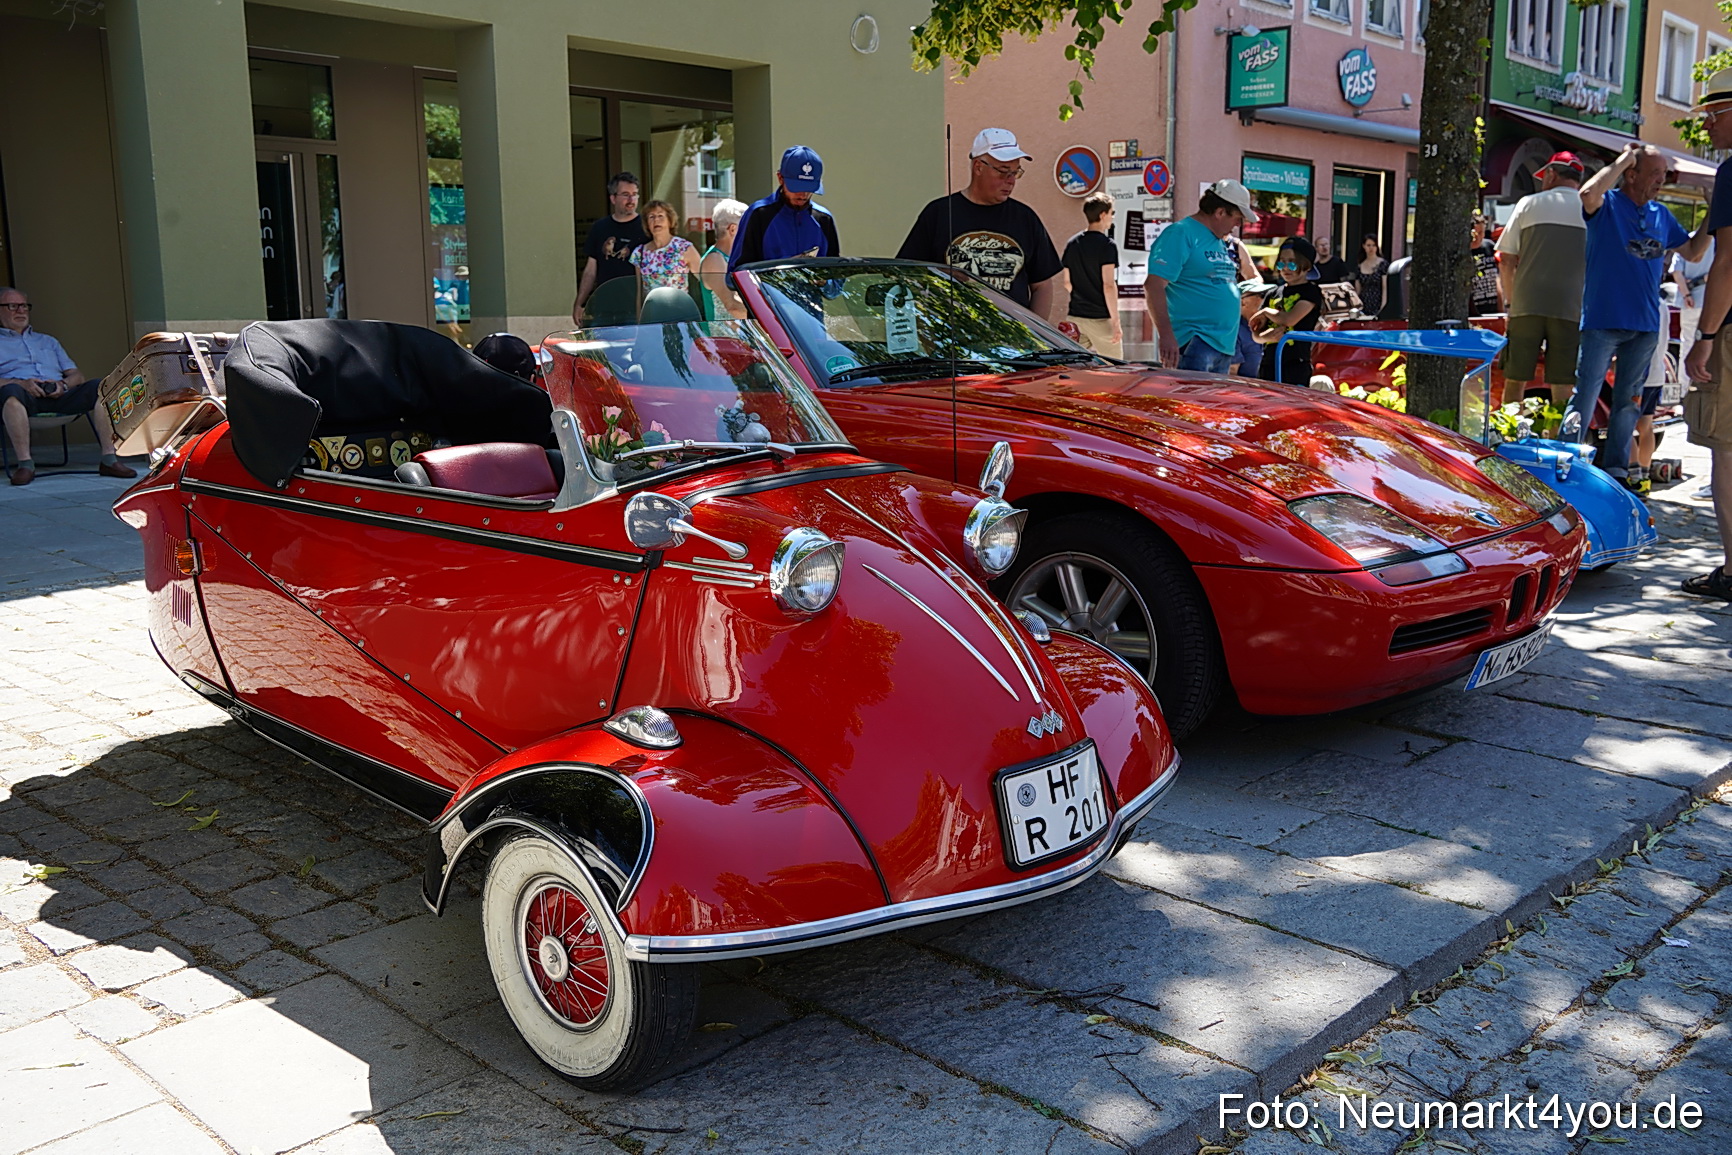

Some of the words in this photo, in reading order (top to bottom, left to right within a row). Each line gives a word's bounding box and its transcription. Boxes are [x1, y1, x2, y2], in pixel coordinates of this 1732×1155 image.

[1245, 46, 1279, 72] FASS
[1344, 68, 1377, 101] FASS
[1284, 170, 1310, 190] Whisky
[960, 236, 1012, 249] Motor
[1046, 758, 1080, 805] HF
[1024, 816, 1051, 856] R
[1064, 790, 1103, 842] 201
